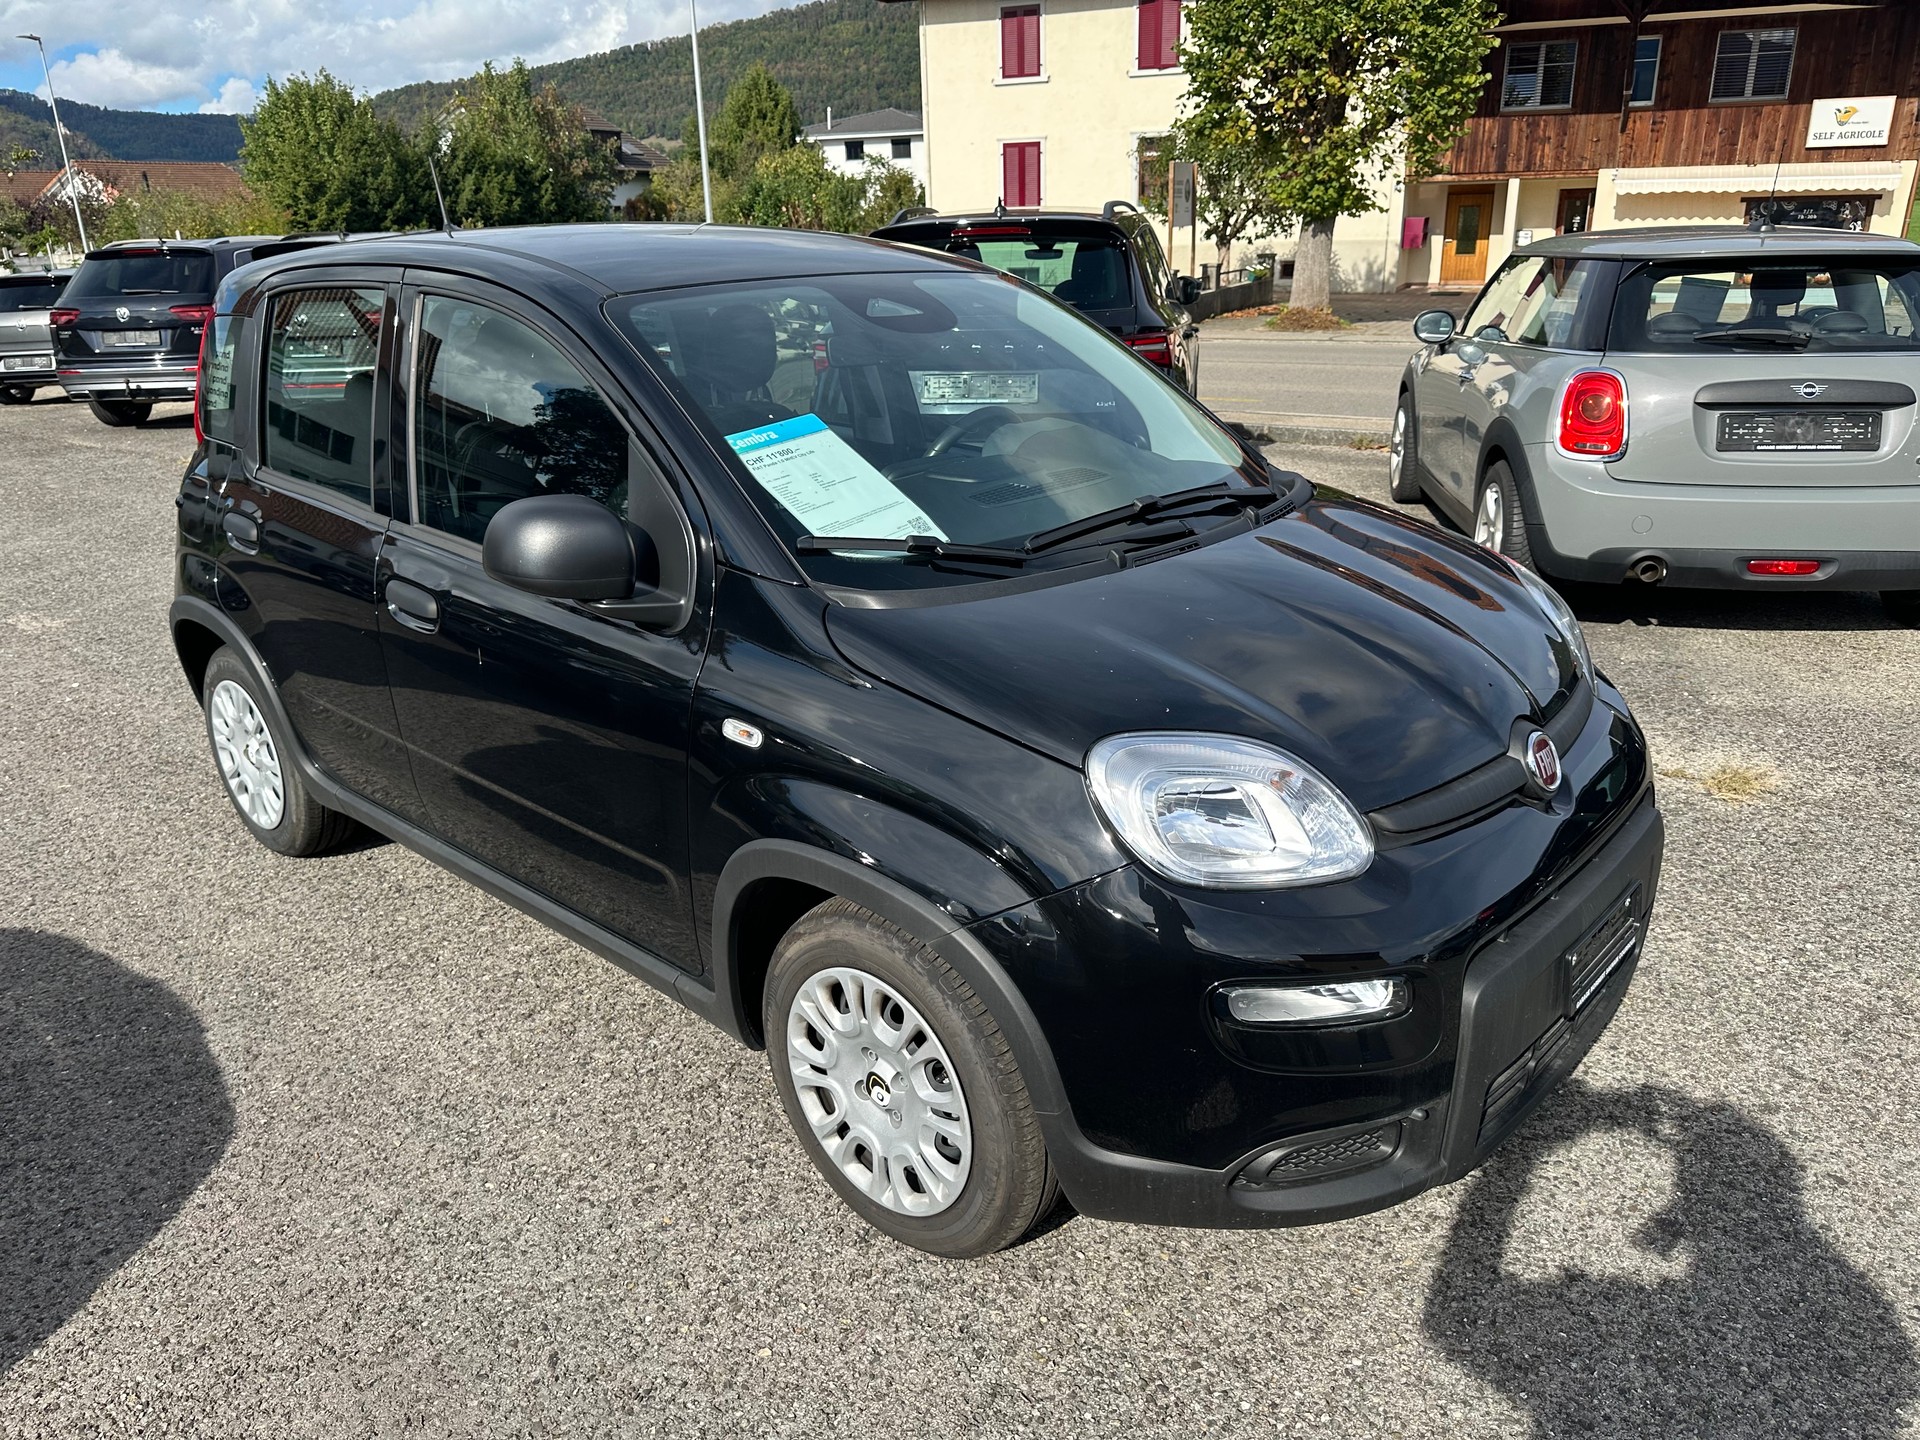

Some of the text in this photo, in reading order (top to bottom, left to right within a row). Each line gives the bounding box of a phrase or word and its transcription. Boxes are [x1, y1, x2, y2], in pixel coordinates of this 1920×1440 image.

[1812, 130, 1884, 140] SELF AGRICOLE
[746, 456, 764, 466] CHF
[1535, 745, 1556, 779] FIAT
